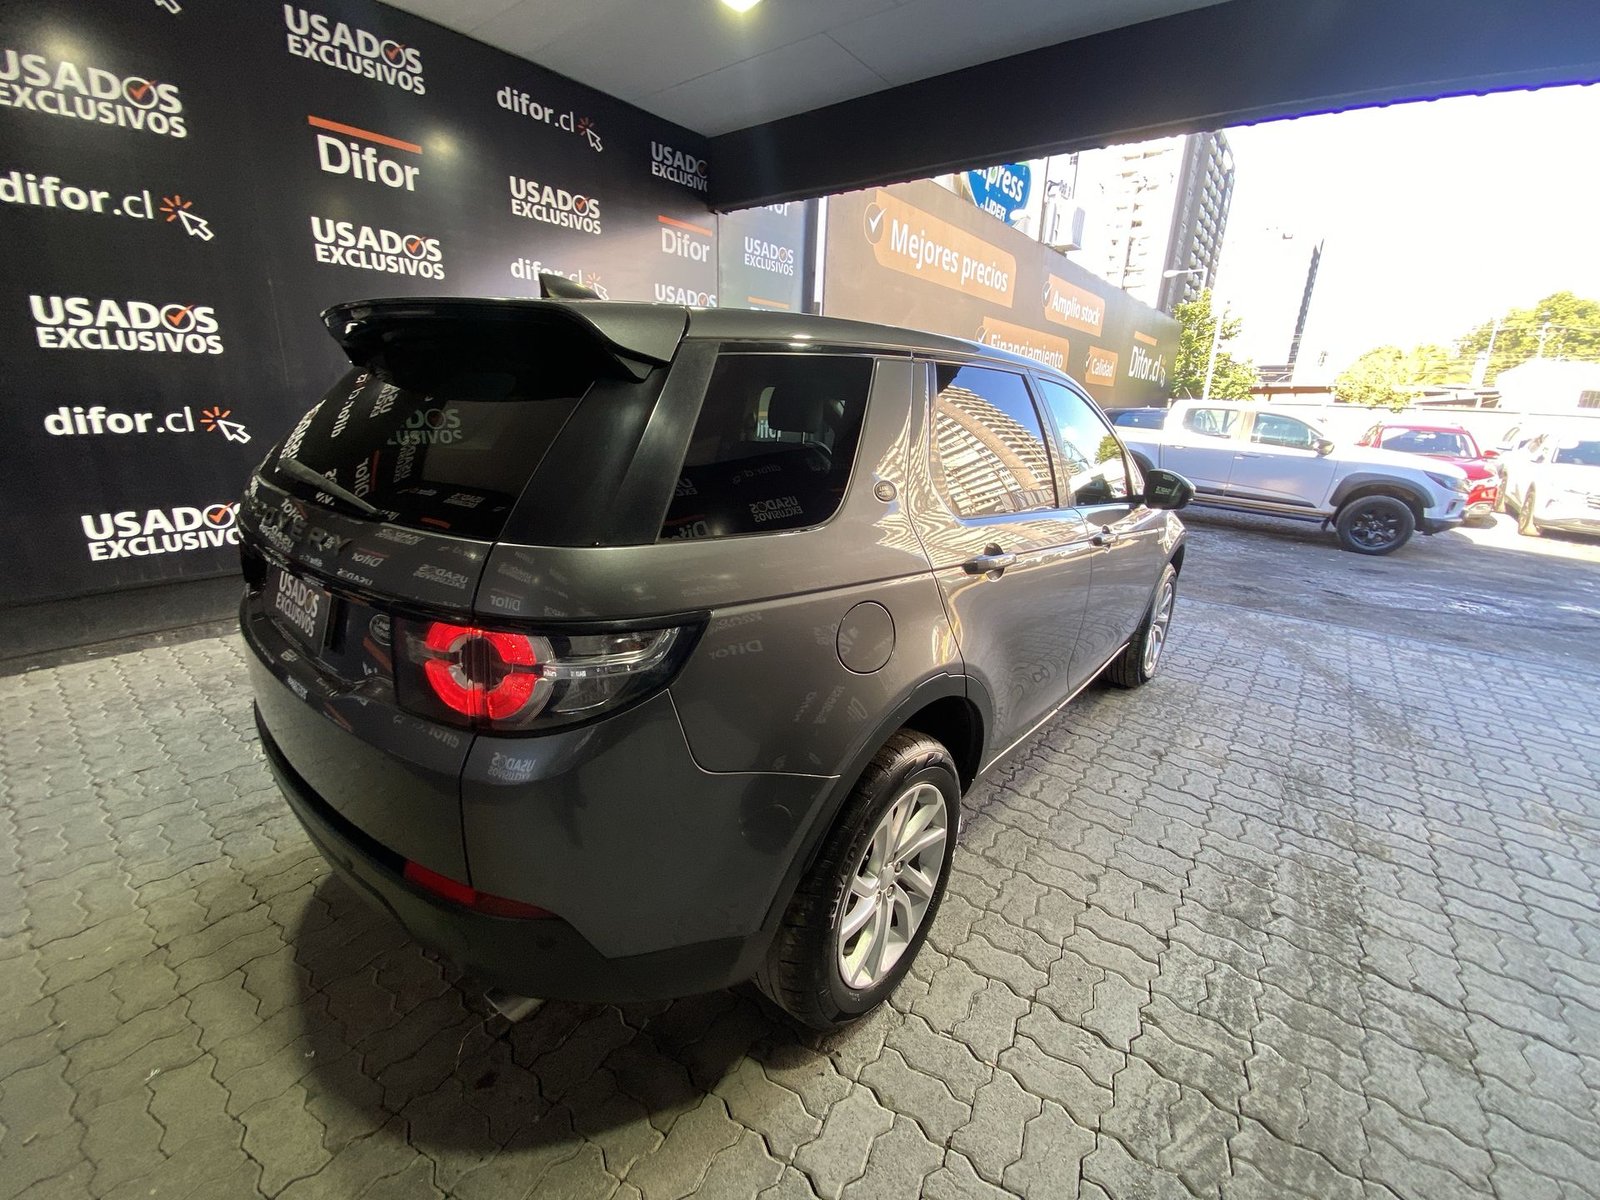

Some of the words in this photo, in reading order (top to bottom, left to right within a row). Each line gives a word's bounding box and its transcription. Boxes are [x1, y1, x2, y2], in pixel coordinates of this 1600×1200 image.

[284, 4, 423, 75] USADOS
[0, 49, 183, 114] USADOS
[287, 34, 426, 95] EXCLUSIVOS
[496, 86, 575, 133] difor.cl
[317, 134, 419, 192] Difor
[651, 141, 708, 179] USADO
[651, 161, 708, 192] EXCLUSIV
[0, 171, 154, 220] difor.cl
[509, 175, 600, 219] USADOS
[984, 196, 1007, 222] LIDER
[511, 198, 601, 235] EXCLUSIVOS
[311, 216, 442, 262] USADOS
[661, 227, 710, 262] Difor
[744, 236, 794, 264] USADOS
[890, 219, 959, 274] Mejores
[960, 255, 1009, 293] precios
[315, 243, 445, 280] EXCLUSIVOS
[744, 253, 794, 276] EXCLUSIVOS
[655, 283, 717, 307] USADOS
[1051, 290, 1080, 321] Amplio
[1080, 305, 1101, 326] stock
[29, 295, 219, 334] USADOS
[36, 327, 224, 355] EXCLUSIVOS
[1091, 356, 1115, 378] Calidad
[1128, 345, 1162, 384] Difor.cl
[44, 406, 195, 435] difor.cl
[88, 526, 240, 561] EXCLUSIVO
[279, 570, 320, 618] USADOS
[275, 592, 316, 637] EXCLUSIVOS
